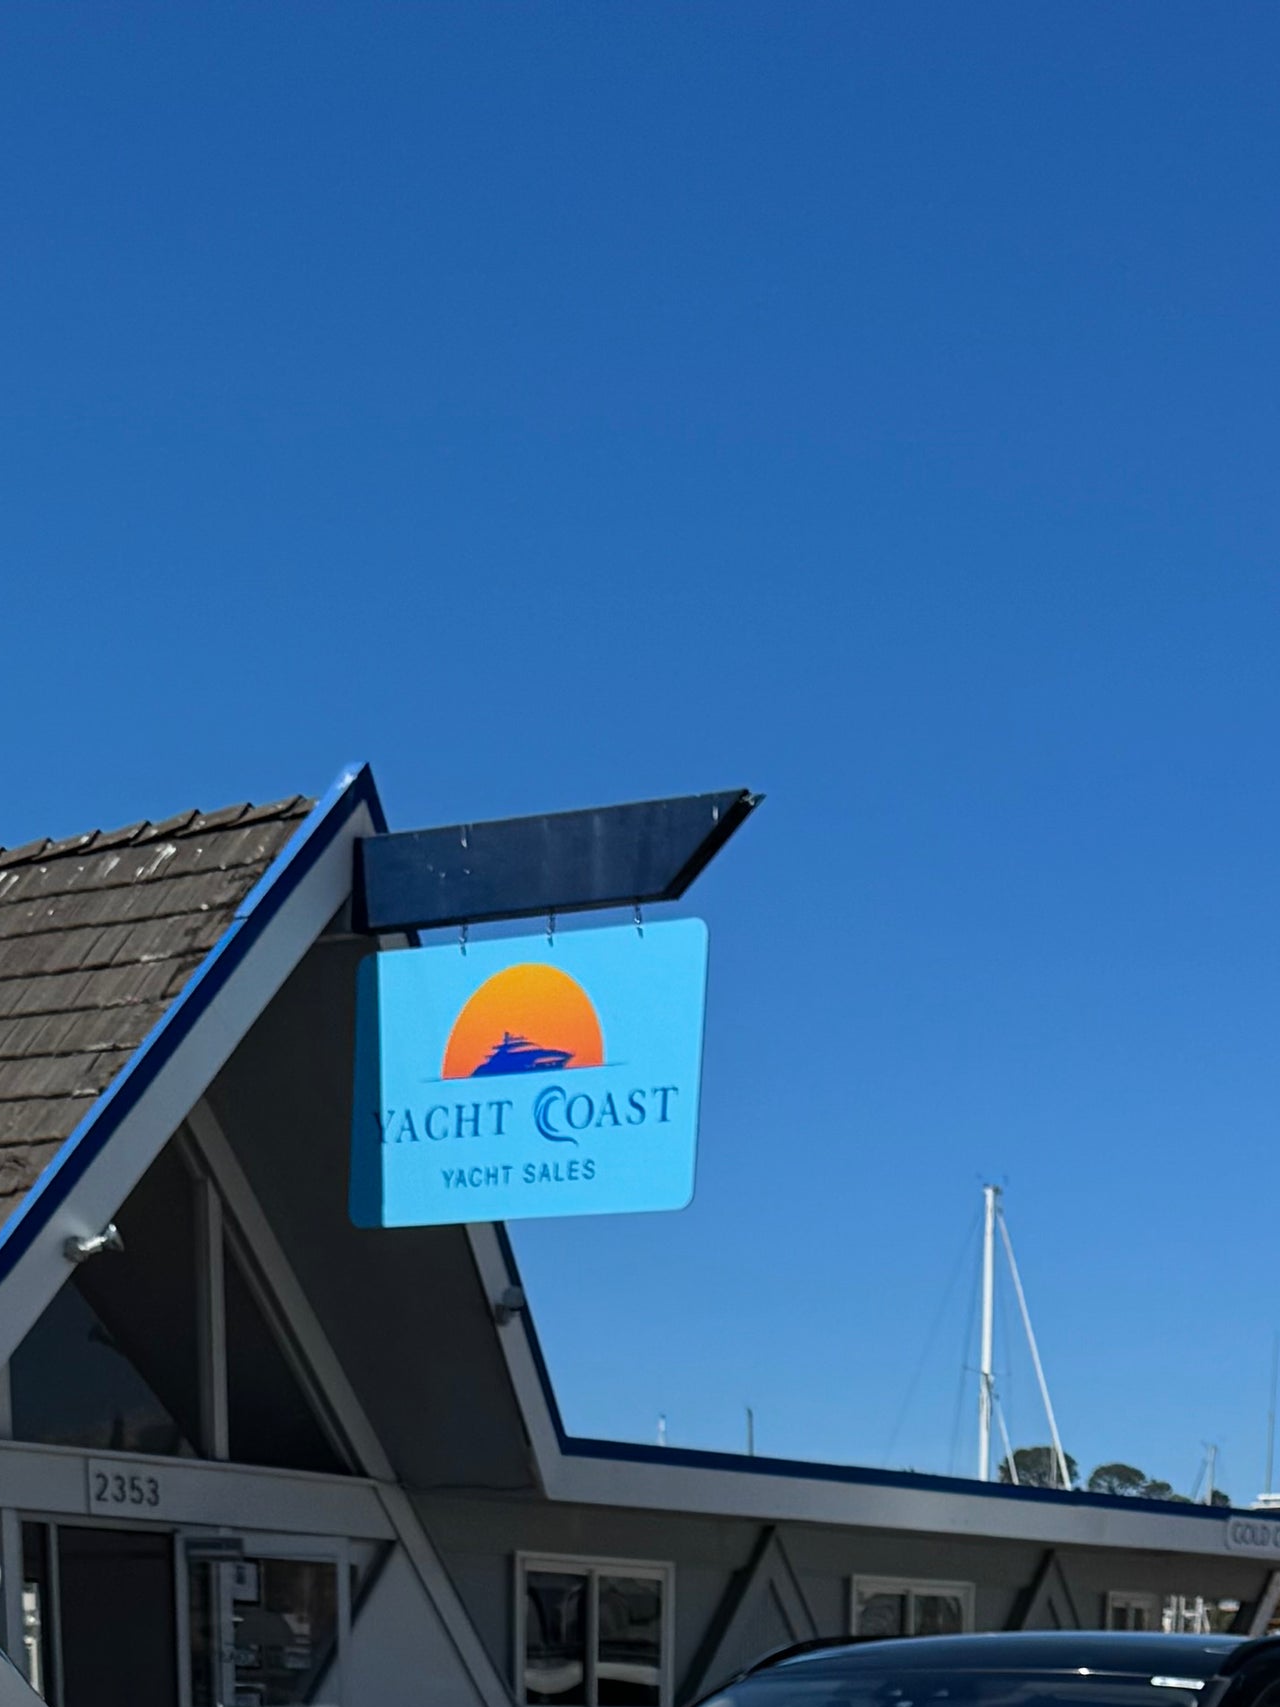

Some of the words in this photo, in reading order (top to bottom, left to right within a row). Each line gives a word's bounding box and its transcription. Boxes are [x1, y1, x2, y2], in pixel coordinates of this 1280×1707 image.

[372, 1100, 513, 1144] YACHT
[533, 1085, 679, 1145] COAST
[442, 1164, 513, 1190] YACHT
[523, 1158, 596, 1186] SALES
[93, 1472, 160, 1507] 2353
